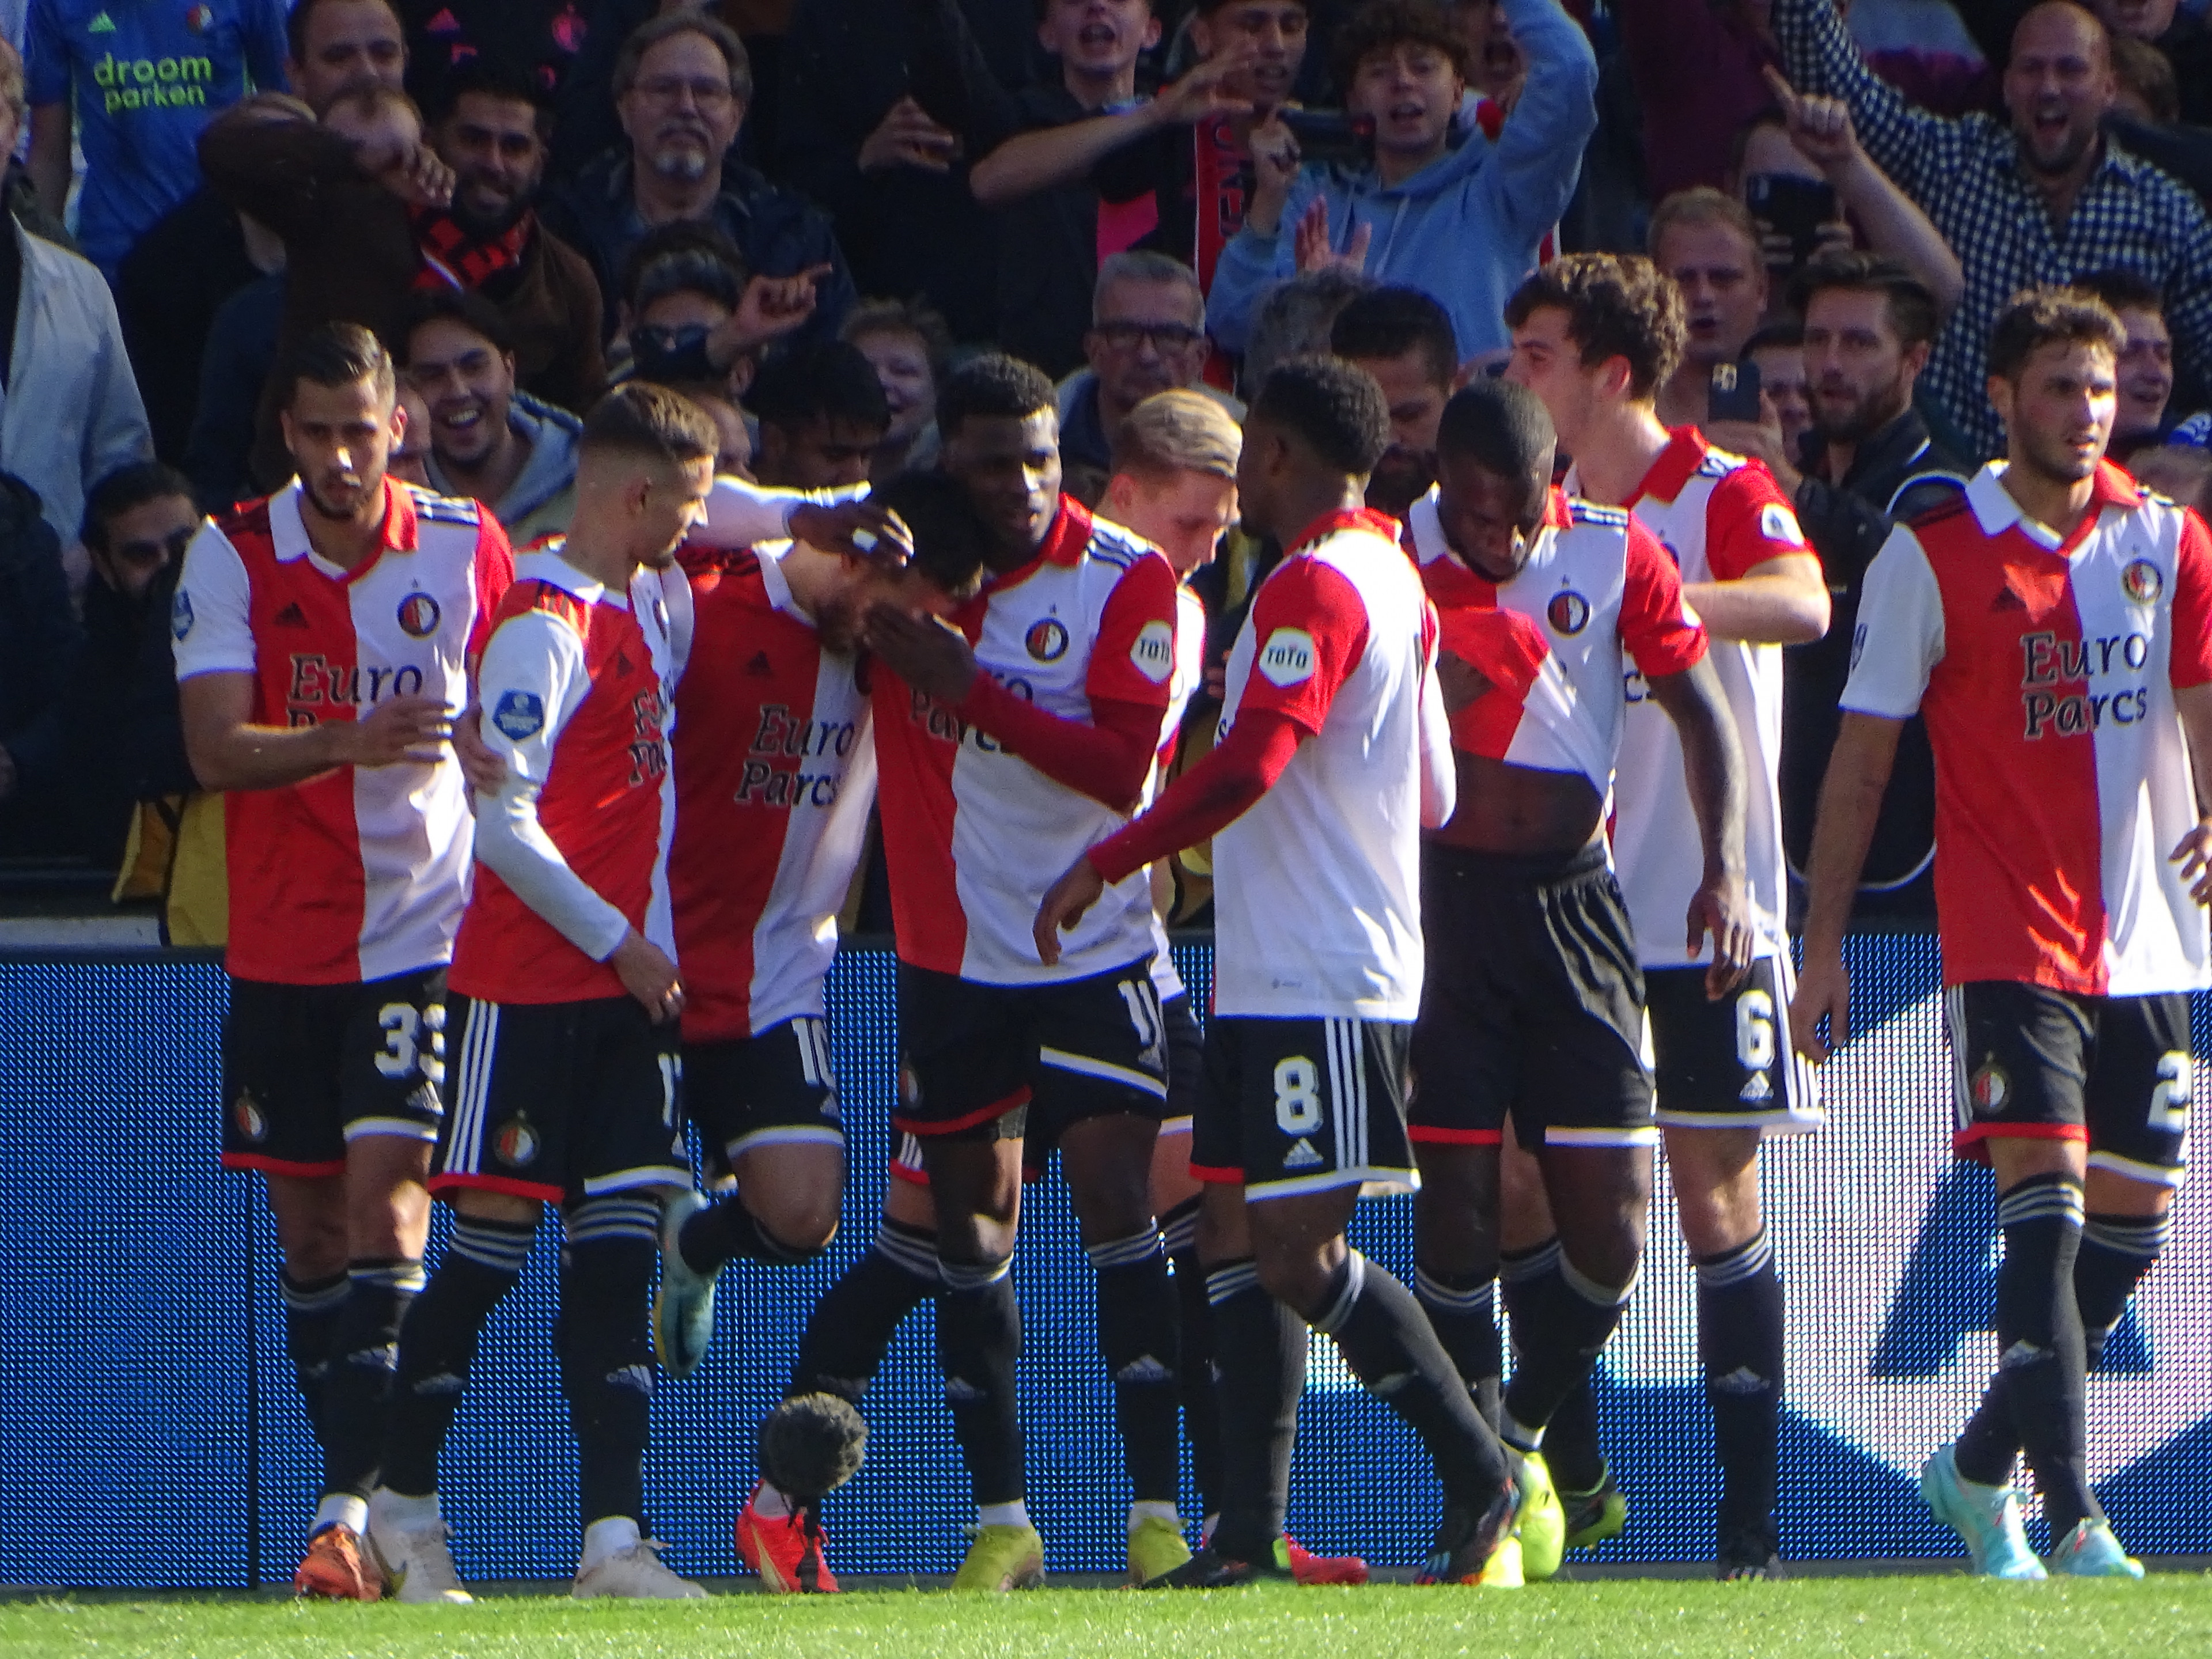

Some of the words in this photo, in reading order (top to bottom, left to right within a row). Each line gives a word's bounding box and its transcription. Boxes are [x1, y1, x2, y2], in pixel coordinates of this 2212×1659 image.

[93, 52, 212, 87] droom
[105, 82, 205, 115] parken
[287, 653, 423, 704] Euro
[1267, 642, 1308, 669] TOTO
[2020, 630, 2147, 685] Euro
[749, 704, 855, 758] Euro
[2021, 687, 2147, 738] Parcs
[1735, 989, 1775, 1071] 6
[1274, 1055, 1323, 1138] 8
